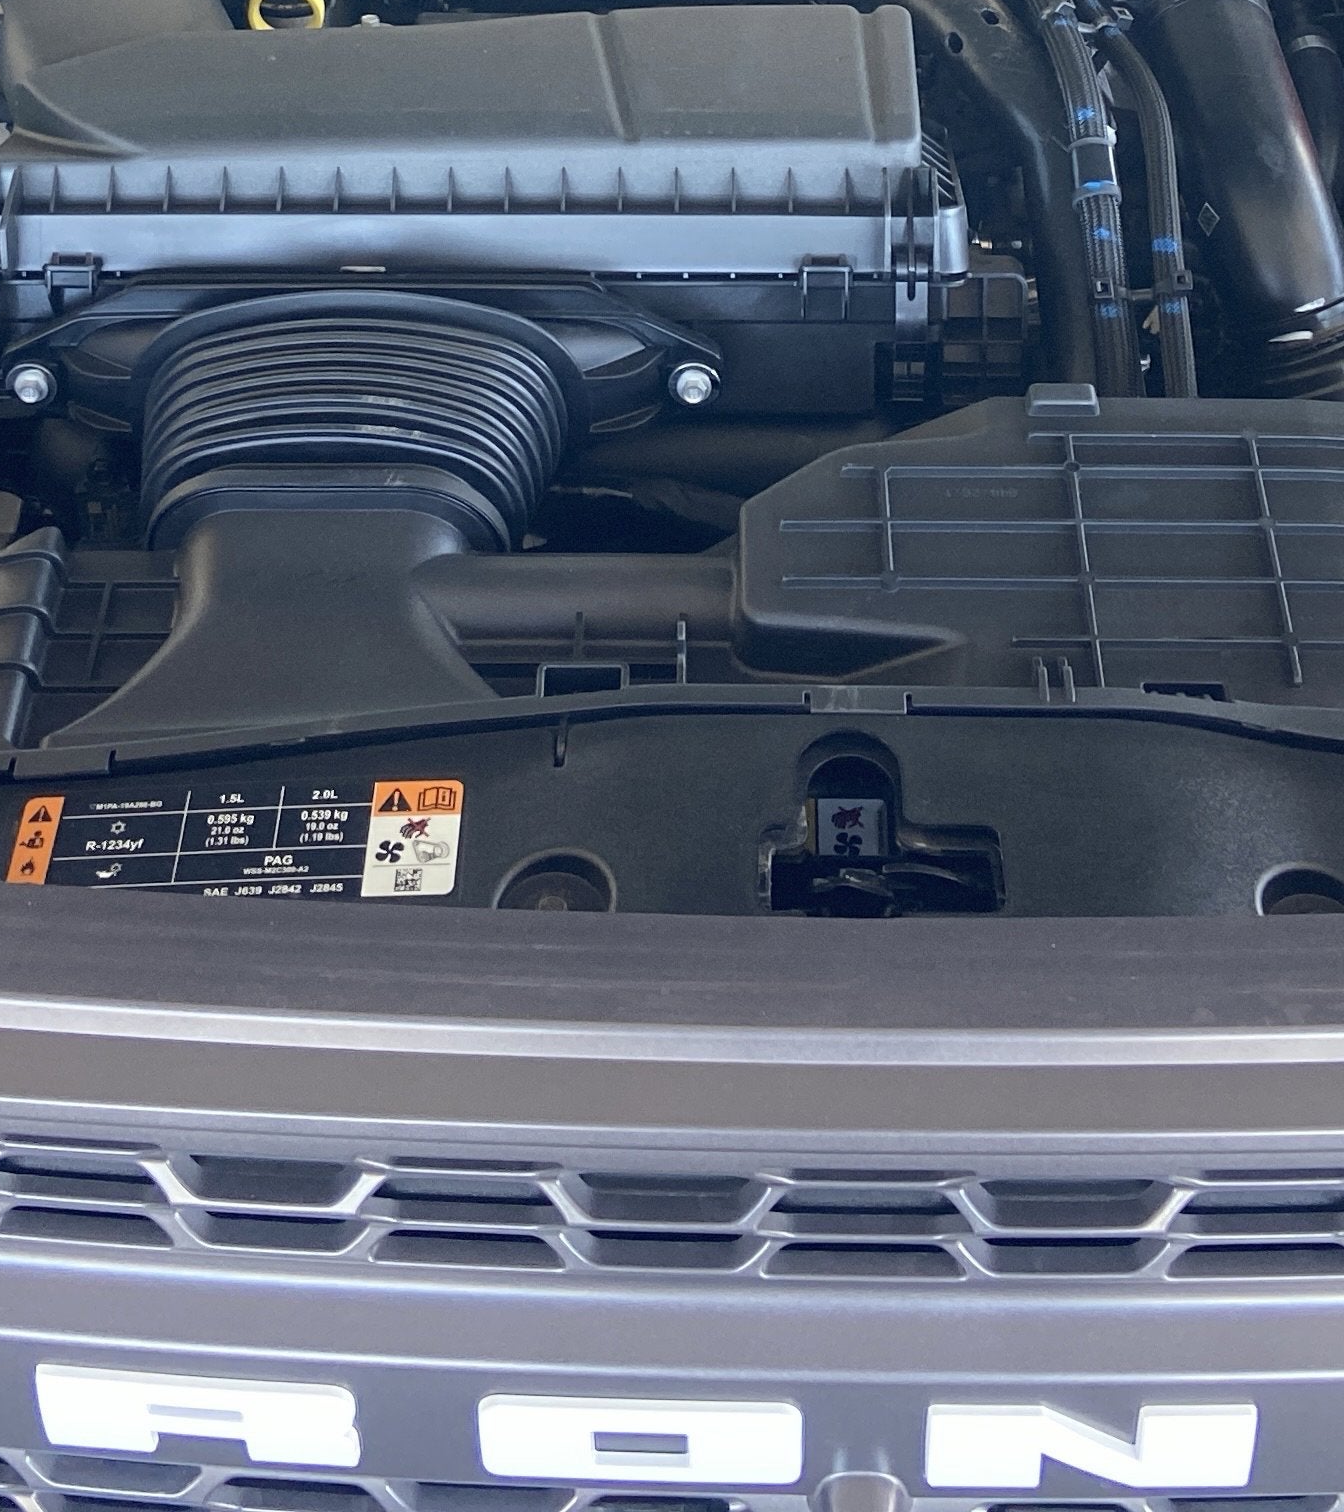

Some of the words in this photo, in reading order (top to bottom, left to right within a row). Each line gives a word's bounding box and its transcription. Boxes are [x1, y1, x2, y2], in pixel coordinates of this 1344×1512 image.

[219, 793, 245, 804] 1.5L
[312, 789, 338, 800] 2.0L
[239, 813, 254, 826] kg
[301, 809, 332, 821] 0.539
[333, 809, 349, 822] kg
[232, 826, 245, 834] oz
[326, 822, 339, 830] oz
[85, 838, 145, 852] R-1234yf
[263, 854, 293, 866] PAG
